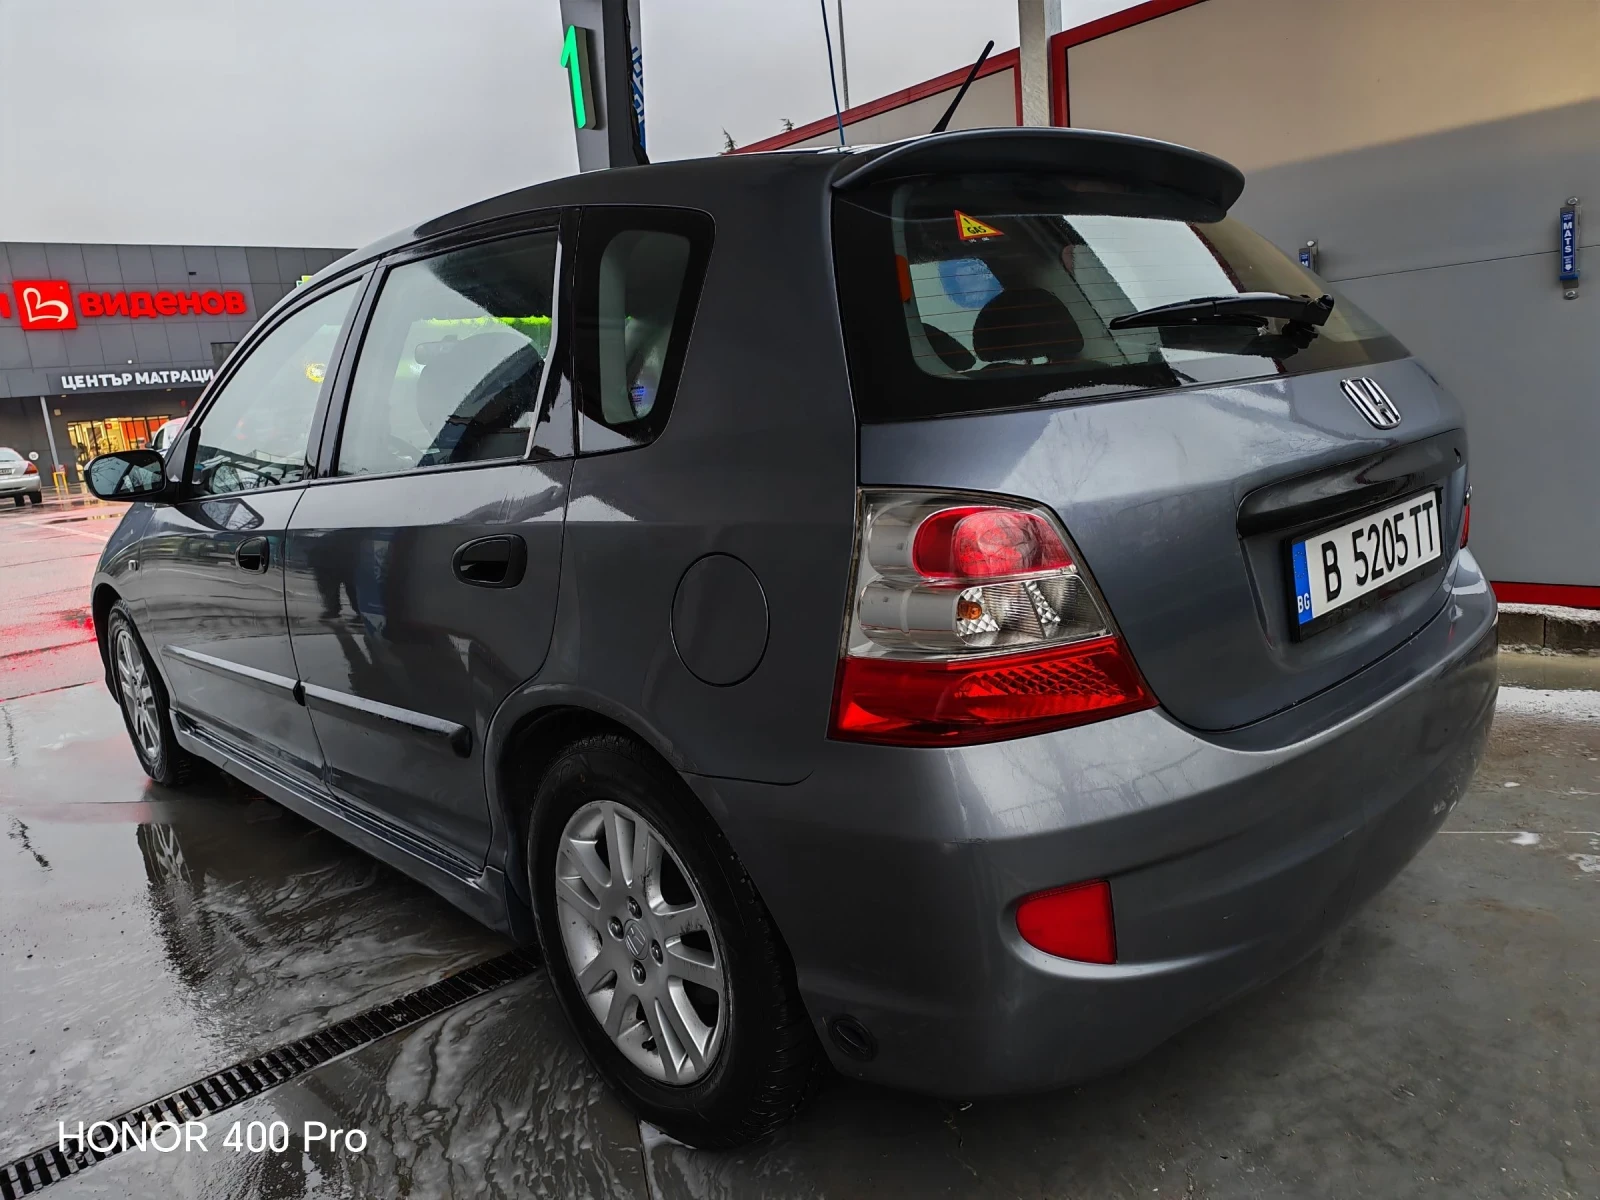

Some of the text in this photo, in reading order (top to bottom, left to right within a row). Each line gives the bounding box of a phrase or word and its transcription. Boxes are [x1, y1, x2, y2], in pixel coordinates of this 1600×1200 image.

[561, 25, 586, 129] 1
[967, 225, 987, 234] GAS
[1563, 222, 1573, 253] MATS
[61, 368, 214, 391] ЦЕНТЪР МАТРАЦИ
[1321, 500, 1433, 603] B 5205 TT
[1297, 592, 1311, 614] BG
